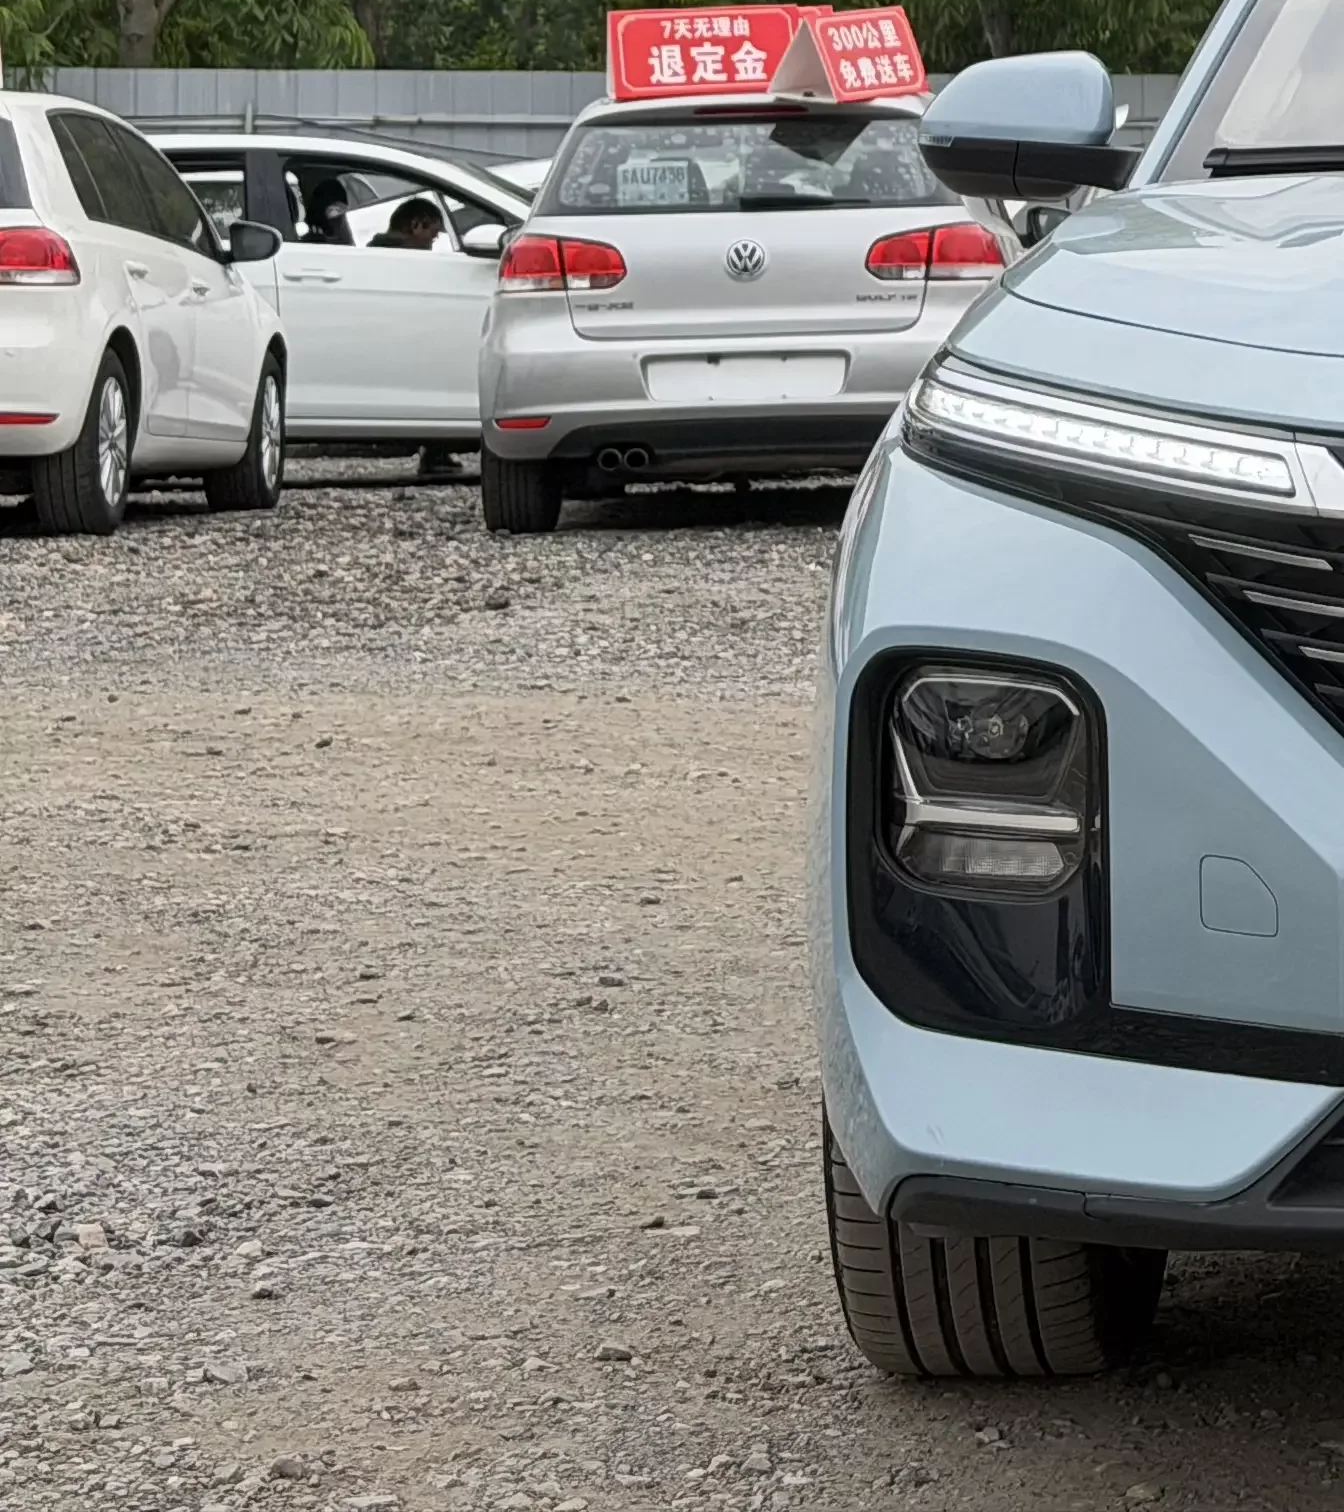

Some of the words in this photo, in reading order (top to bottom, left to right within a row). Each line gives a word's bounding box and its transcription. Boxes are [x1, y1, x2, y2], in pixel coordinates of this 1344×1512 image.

[660, 16, 751, 40] 7天无理由
[828, 18, 902, 52] 300公里
[648, 40, 768, 84] 退定金
[838, 53, 915, 89] 免费送车
